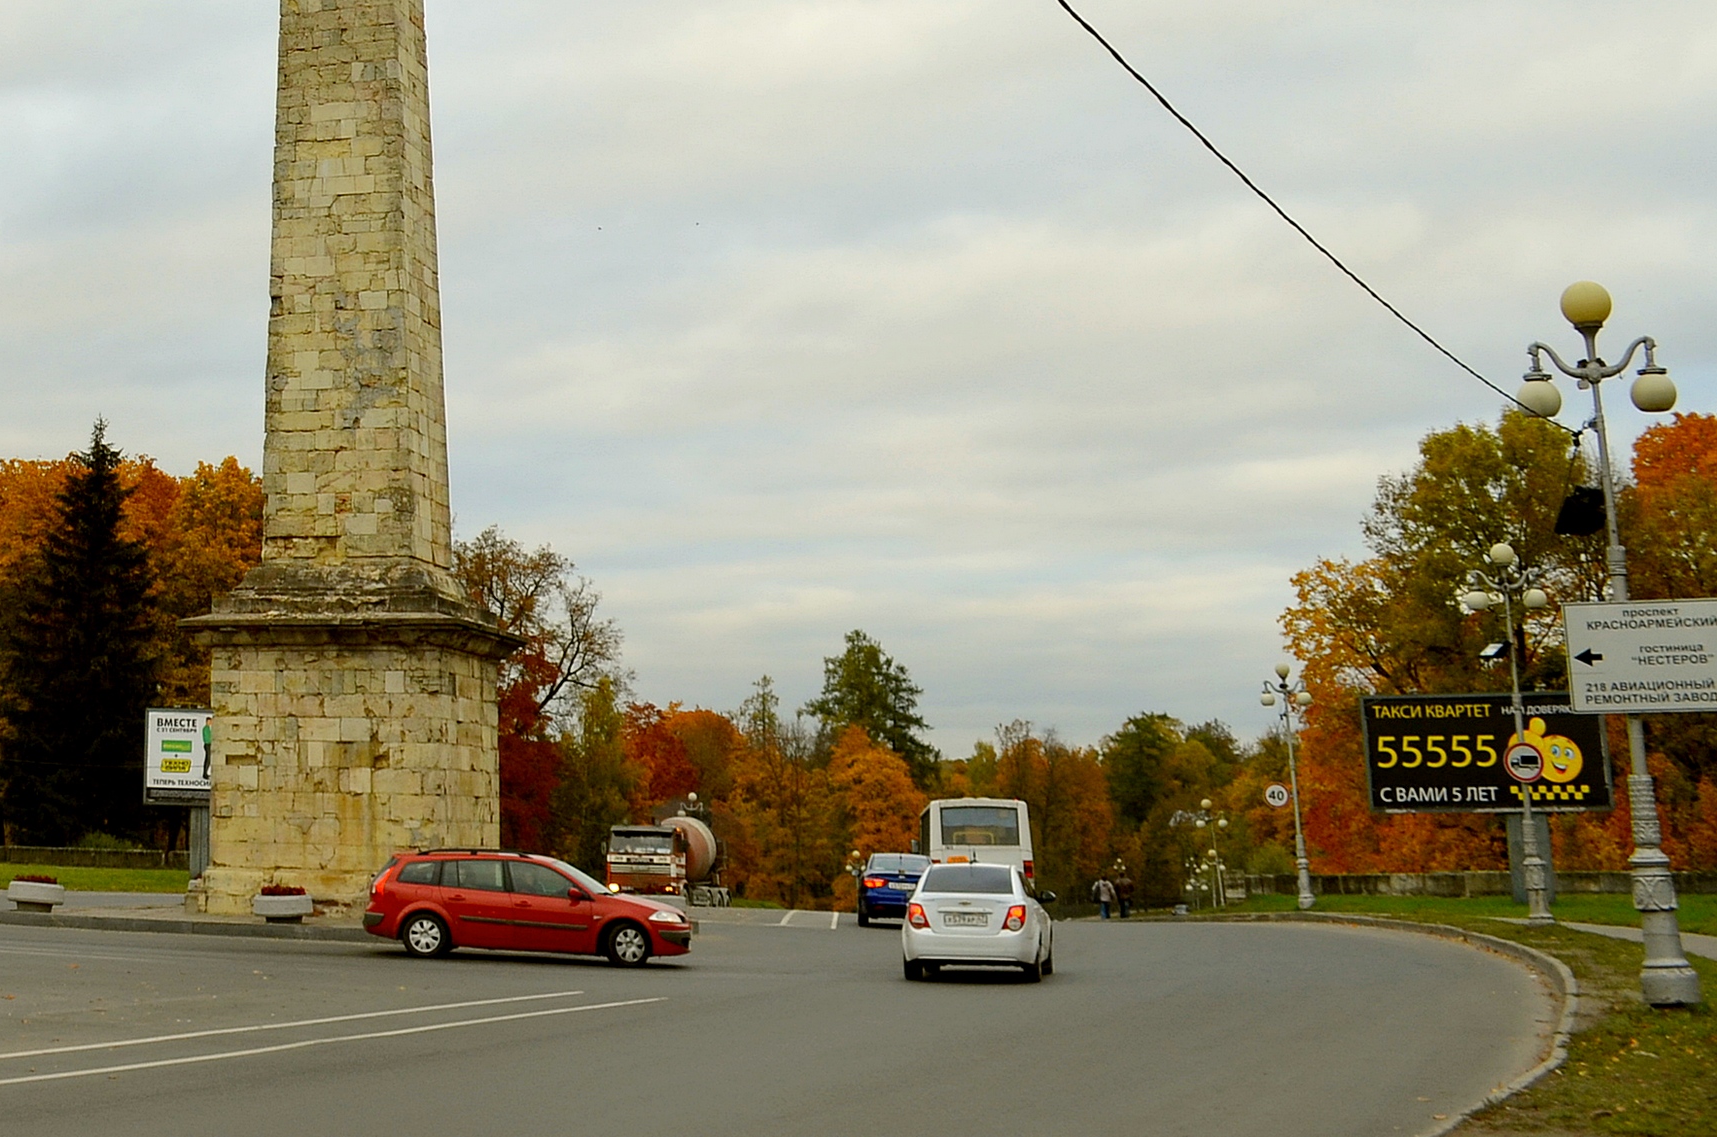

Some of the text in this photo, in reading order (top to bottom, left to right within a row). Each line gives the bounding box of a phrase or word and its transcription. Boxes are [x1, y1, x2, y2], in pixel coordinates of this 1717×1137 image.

[1622, 608, 1679, 618] проспект
[1639, 644, 1704, 654] гостиница
[1586, 678, 1715, 692] 218 АВИАЦИОННЫЙ
[1586, 691, 1670, 705] РЕМОНТНЫЙ
[1372, 704, 1491, 718] ТАКСИ КВАРТЕТ
[157, 718, 197, 727] ВМЕСТЕ
[1378, 735, 1497, 768] 55555
[1268, 790, 1284, 801] 40
[1380, 786, 1498, 803] С ВАМИ 5 ЛЕТ
